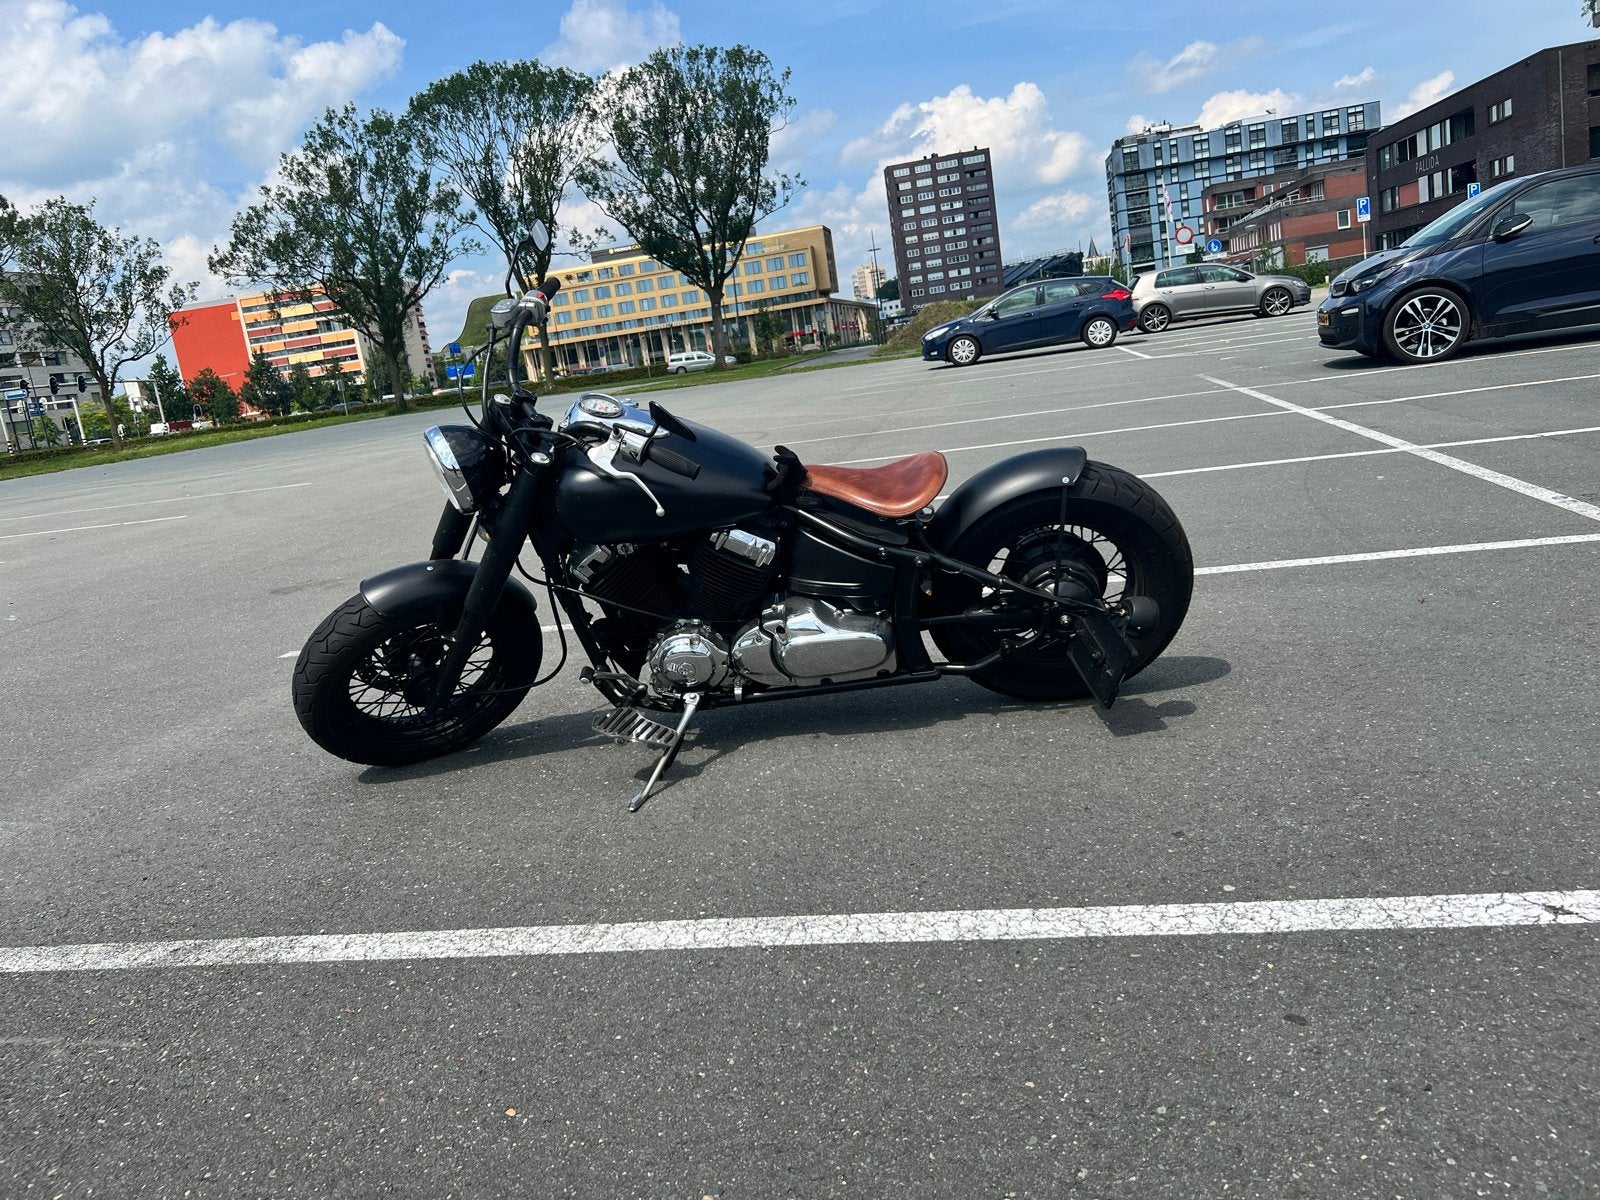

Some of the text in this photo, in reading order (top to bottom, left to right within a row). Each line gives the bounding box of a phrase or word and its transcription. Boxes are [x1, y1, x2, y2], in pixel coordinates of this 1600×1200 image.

[1415, 154, 1440, 174] PALLIDA
[1471, 184, 1478, 193] P
[1360, 199, 1367, 208] P
